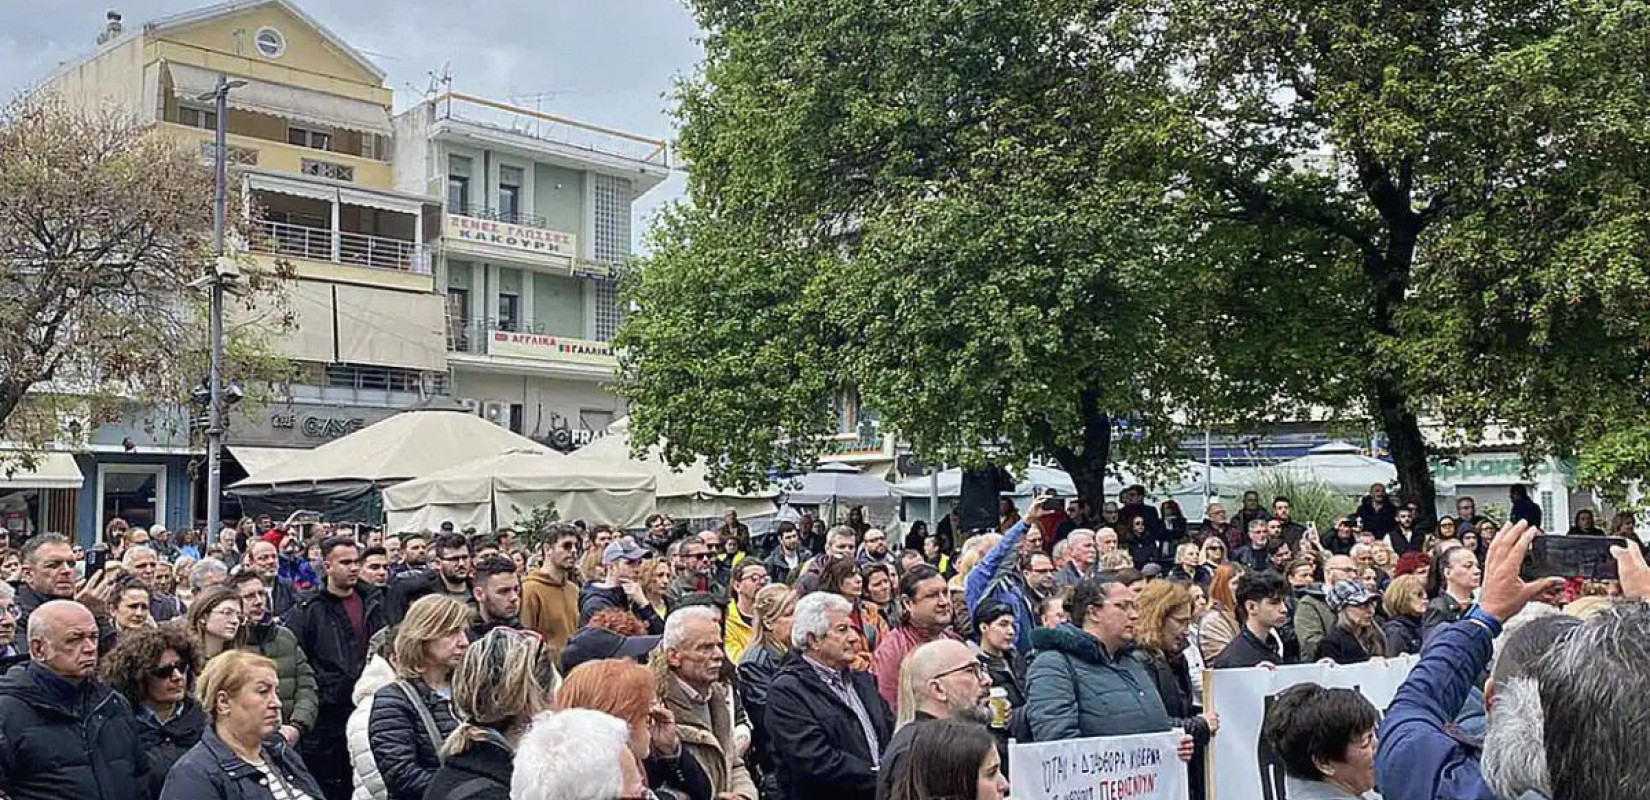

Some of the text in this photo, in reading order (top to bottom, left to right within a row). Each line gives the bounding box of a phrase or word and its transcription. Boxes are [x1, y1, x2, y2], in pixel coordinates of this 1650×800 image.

[460, 230, 560, 251] ΚΑΚΟΥΡΗ
[507, 226, 570, 244] ΓΛΩΣΣΕΣ
[512, 334, 557, 346] ΑΓΓΛΙΚΑ
